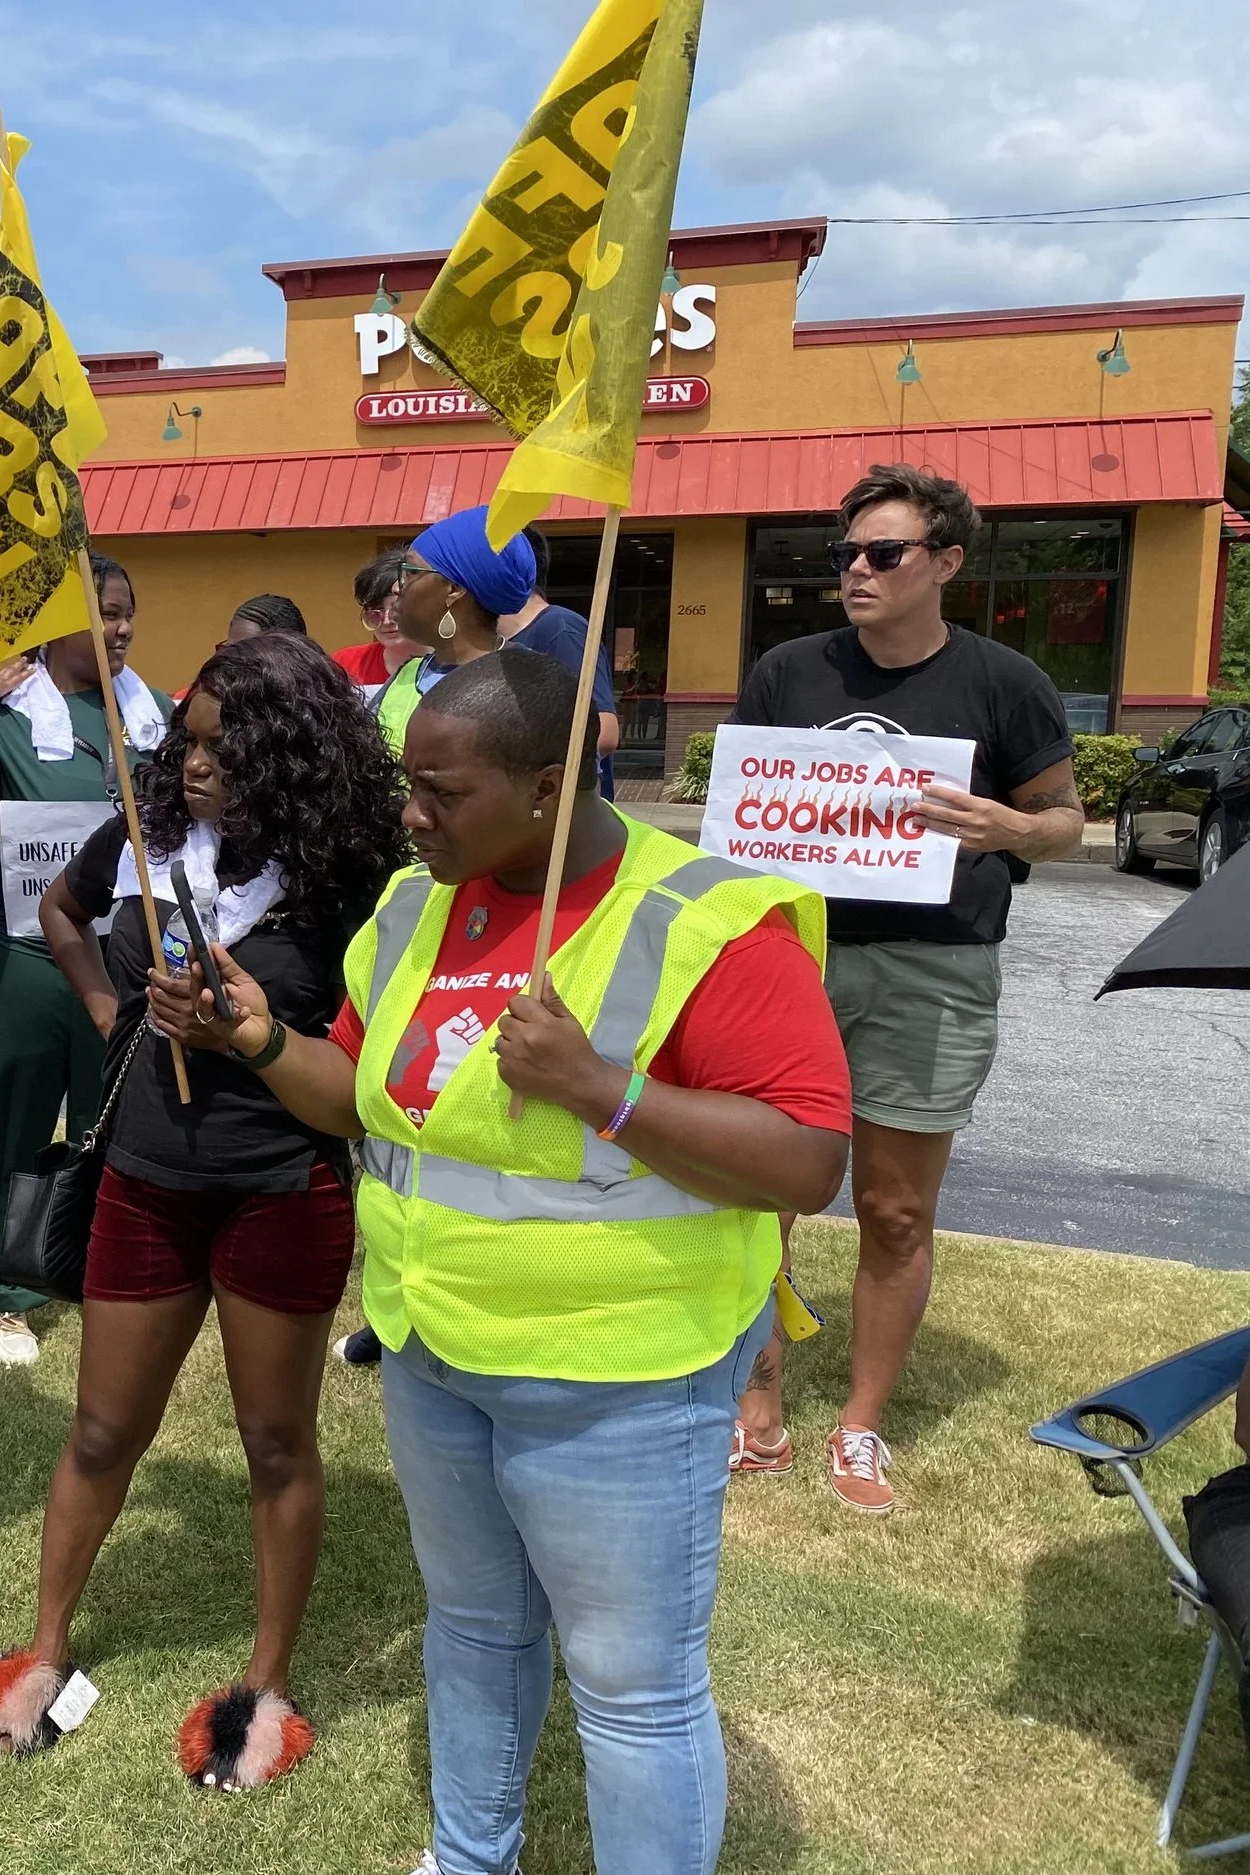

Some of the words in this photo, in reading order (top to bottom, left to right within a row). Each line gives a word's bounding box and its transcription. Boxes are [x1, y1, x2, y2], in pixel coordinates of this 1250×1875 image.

[678, 604, 706, 616] 2665
[740, 757, 795, 780] OUR
[801, 761, 869, 784] JOBS
[734, 799, 925, 840] COOKING
[728, 839, 837, 864] WORKERS
[843, 848, 921, 868] ALIVE
